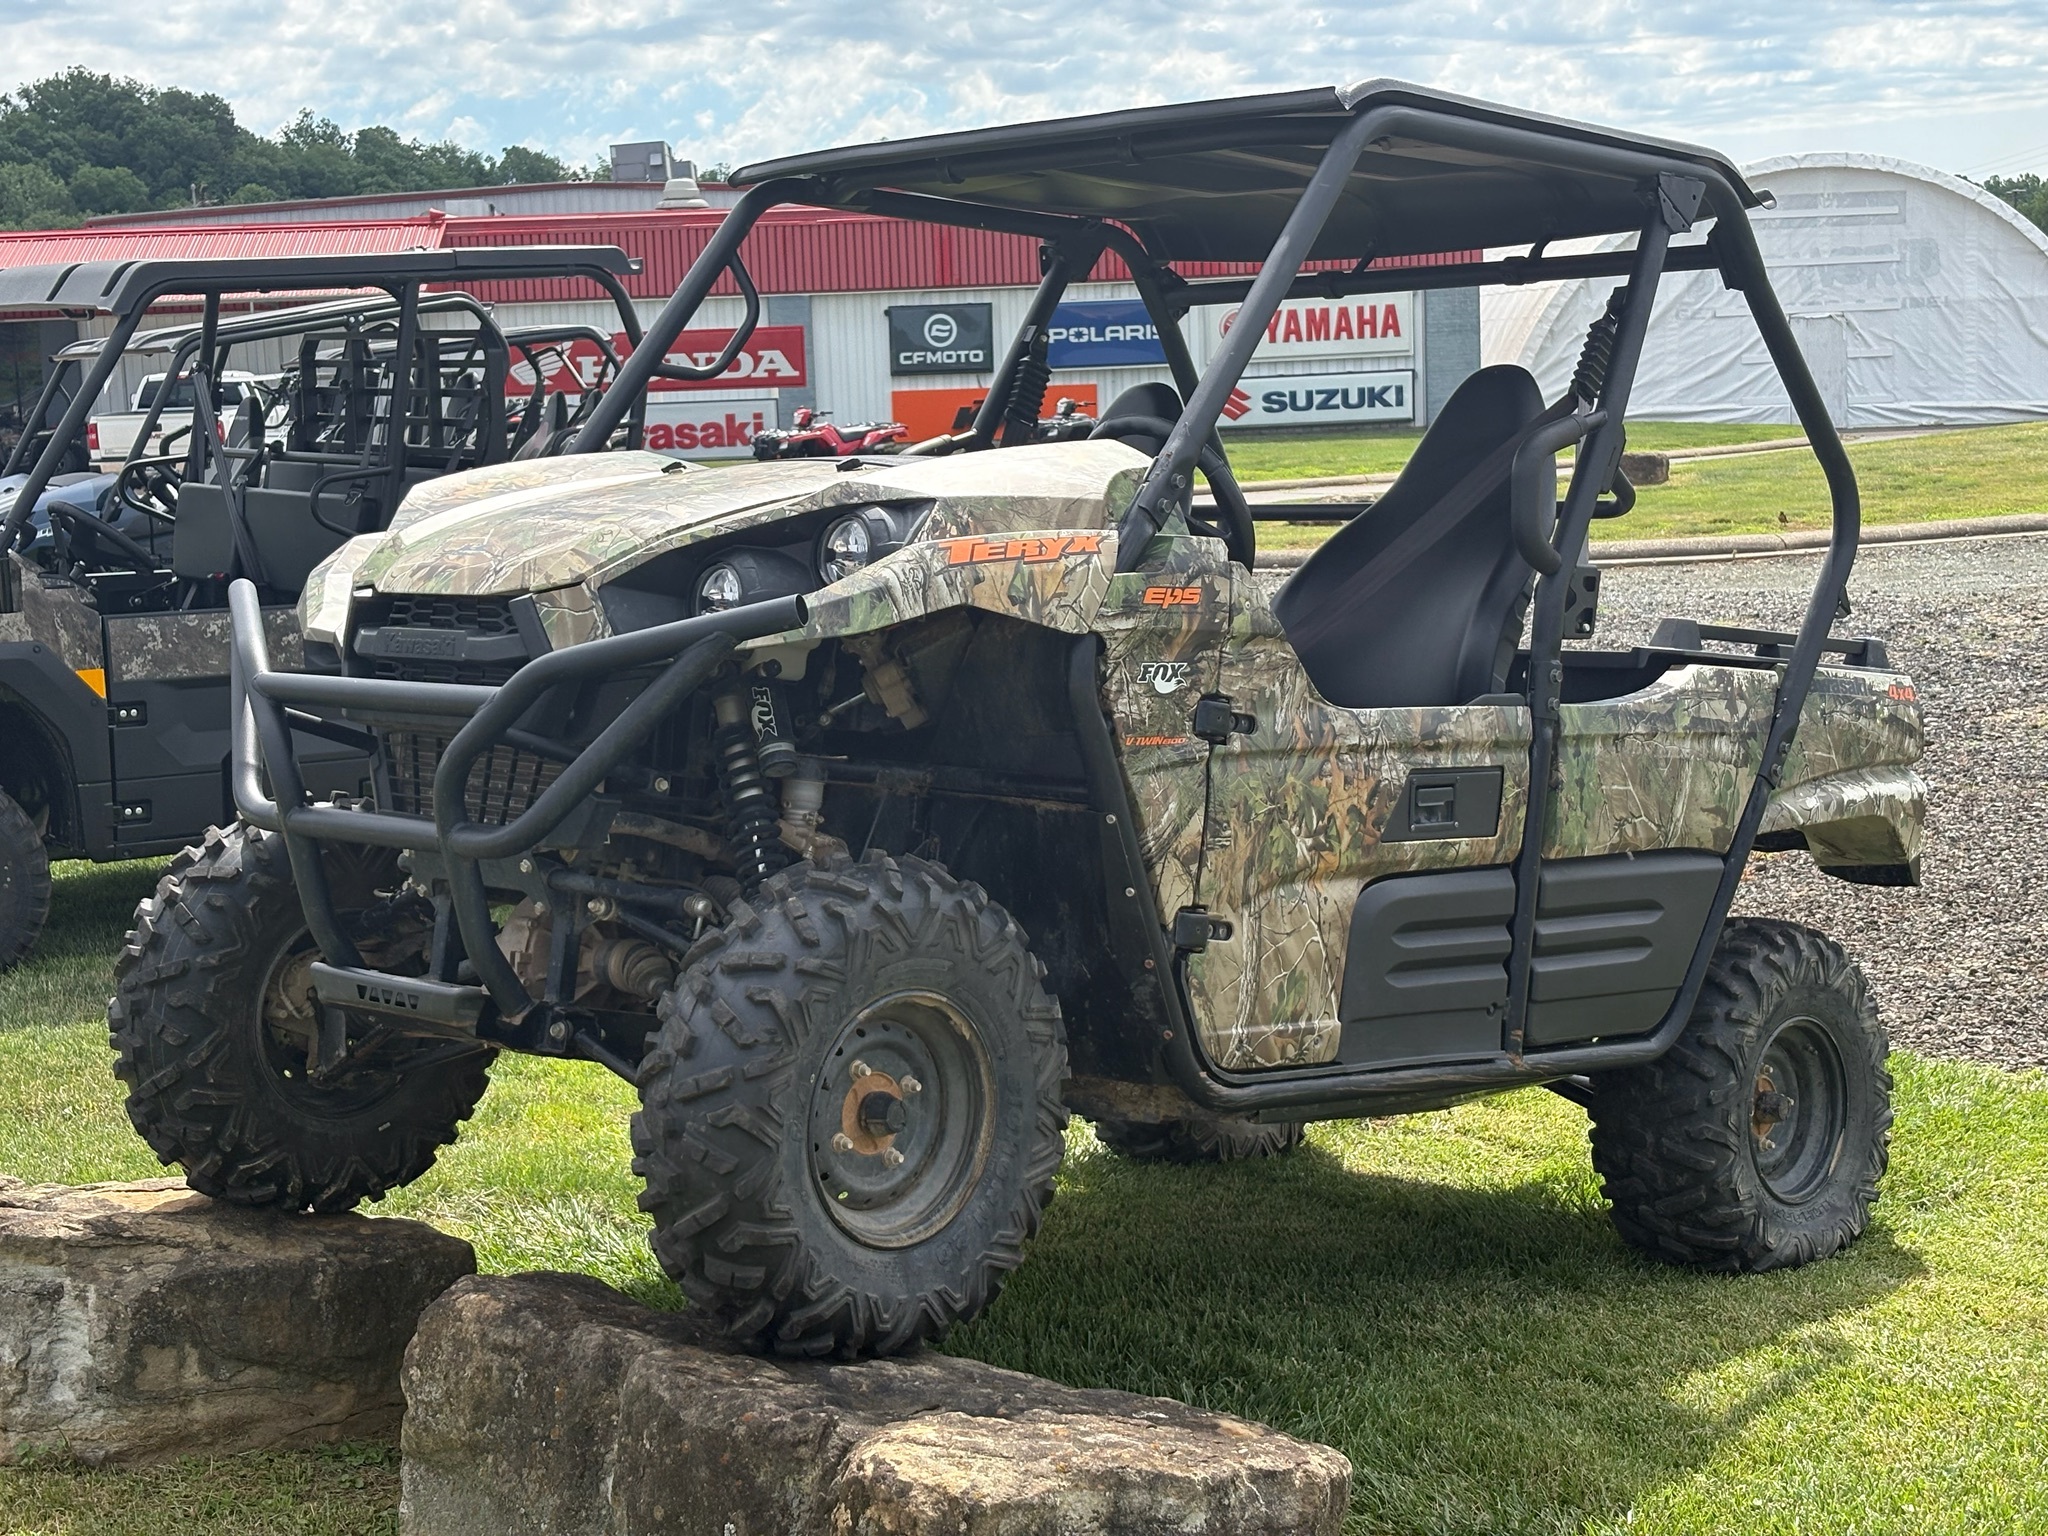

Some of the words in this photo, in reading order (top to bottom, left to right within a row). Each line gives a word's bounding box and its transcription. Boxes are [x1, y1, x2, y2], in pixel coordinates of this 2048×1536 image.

[1266, 304, 1402, 344] YAMAHA
[576, 349, 800, 384] HNDA
[899, 350, 984, 365] CFMOTO
[1261, 384, 1404, 414] SUZUKI
[642, 412, 764, 450] asaki
[384, 631, 456, 656] Kawasaki
[1137, 662, 1188, 689] FOX
[752, 687, 778, 738] FOX
